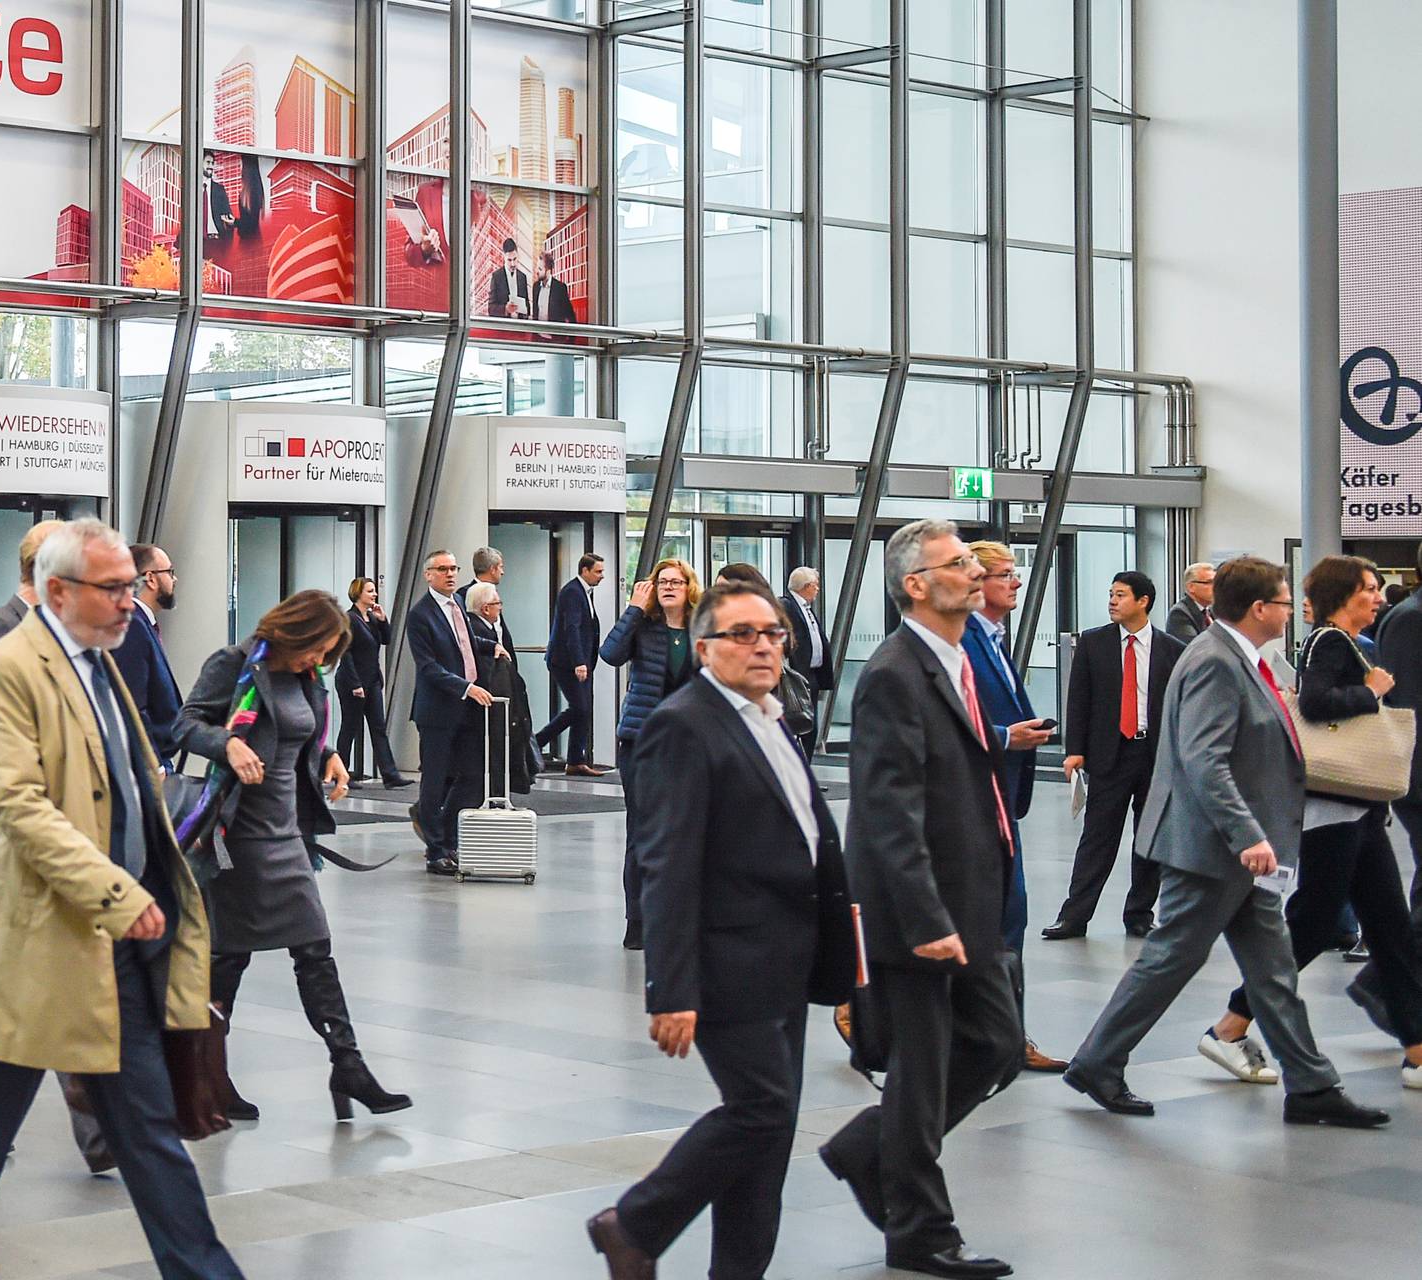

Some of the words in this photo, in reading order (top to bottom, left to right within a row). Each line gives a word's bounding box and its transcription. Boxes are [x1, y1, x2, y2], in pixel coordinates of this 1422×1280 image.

[9, 439, 59, 452] HAMBURG
[510, 442, 541, 457] AUF
[547, 442, 621, 461] WIEDERSEHEN
[24, 457, 72, 469] STUTTGART
[516, 463, 546, 473] BERLIN
[557, 465, 596, 476] HAMBURG
[244, 464, 300, 480] Partner
[306, 463, 325, 481] für
[506, 478, 559, 488] FRANKFURT
[570, 479, 606, 490] STUTTGART
